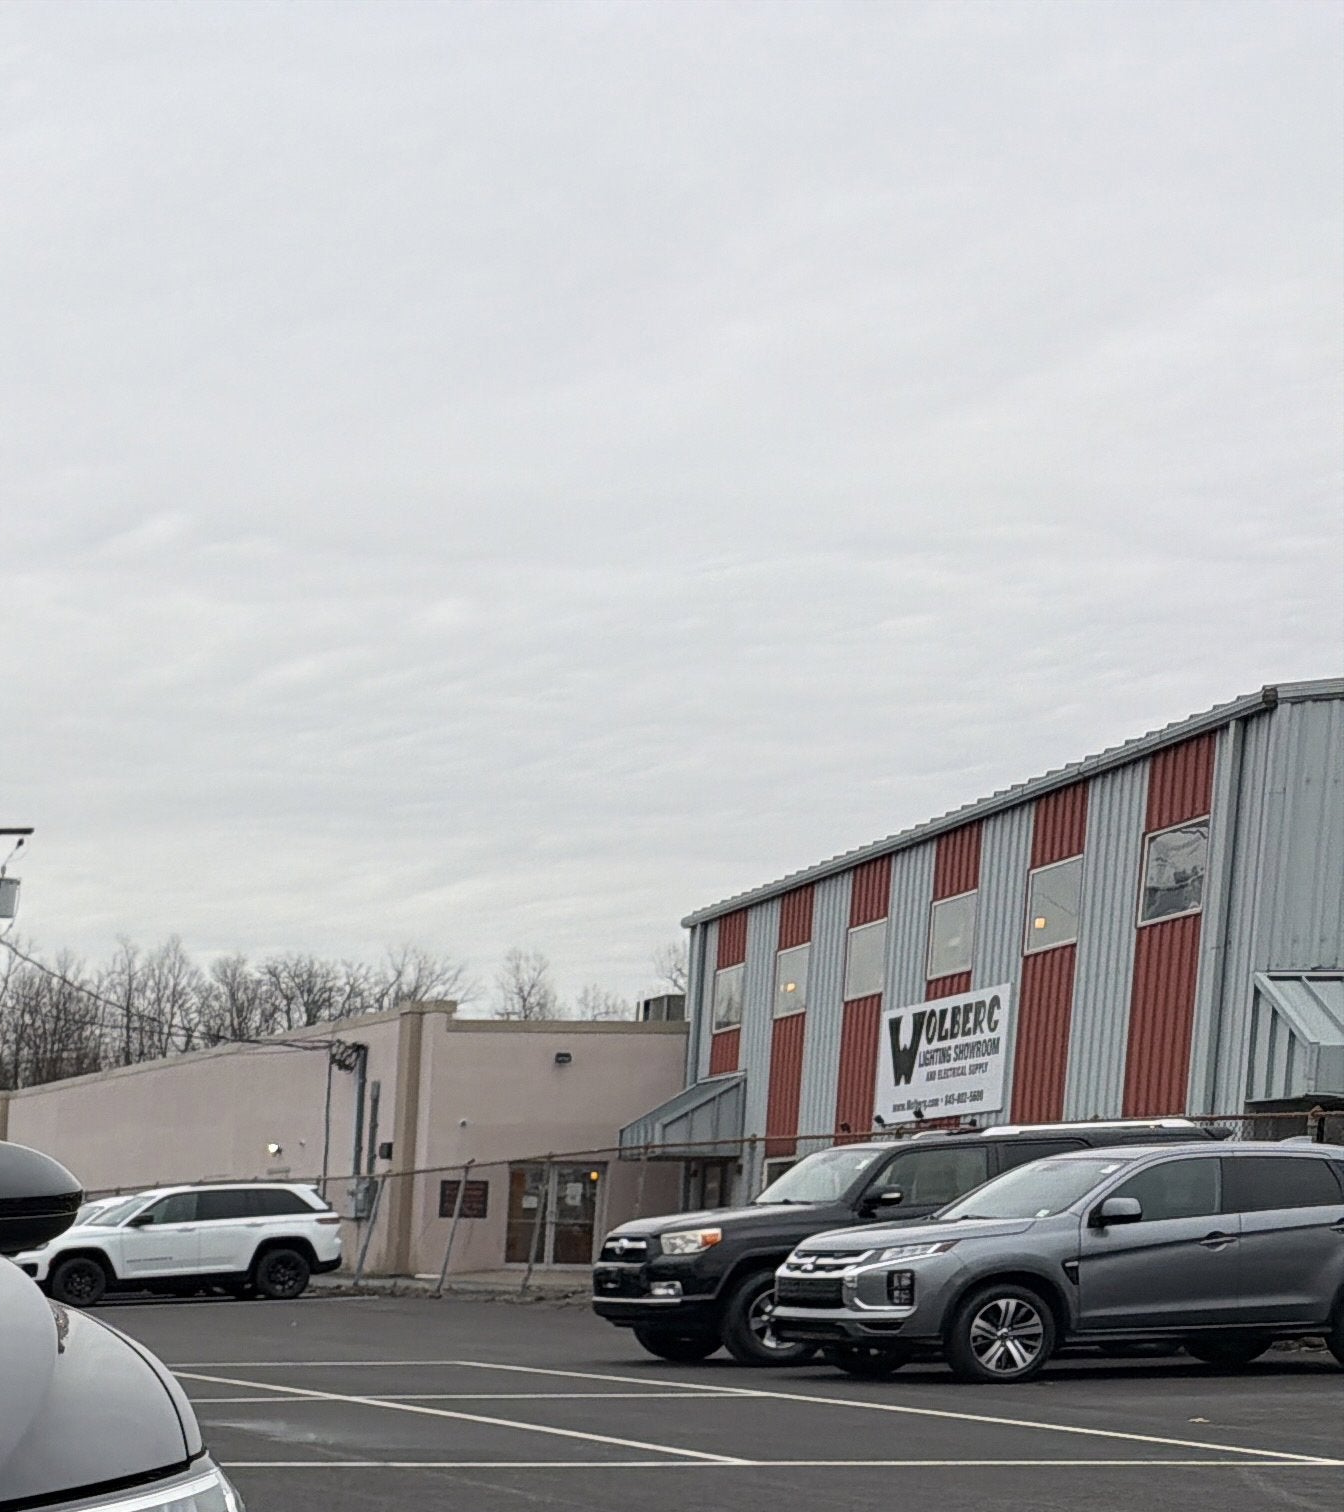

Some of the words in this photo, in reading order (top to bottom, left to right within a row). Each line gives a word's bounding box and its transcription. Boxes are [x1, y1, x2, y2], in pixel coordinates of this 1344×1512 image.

[918, 1045, 952, 1068] LIGHTING
[953, 1037, 1001, 1062] SHOWROOM
[926, 1069, 937, 1081] AND
[938, 1066, 967, 1080] ELECTRICAL
[968, 1062, 989, 1076] SUPPLY
